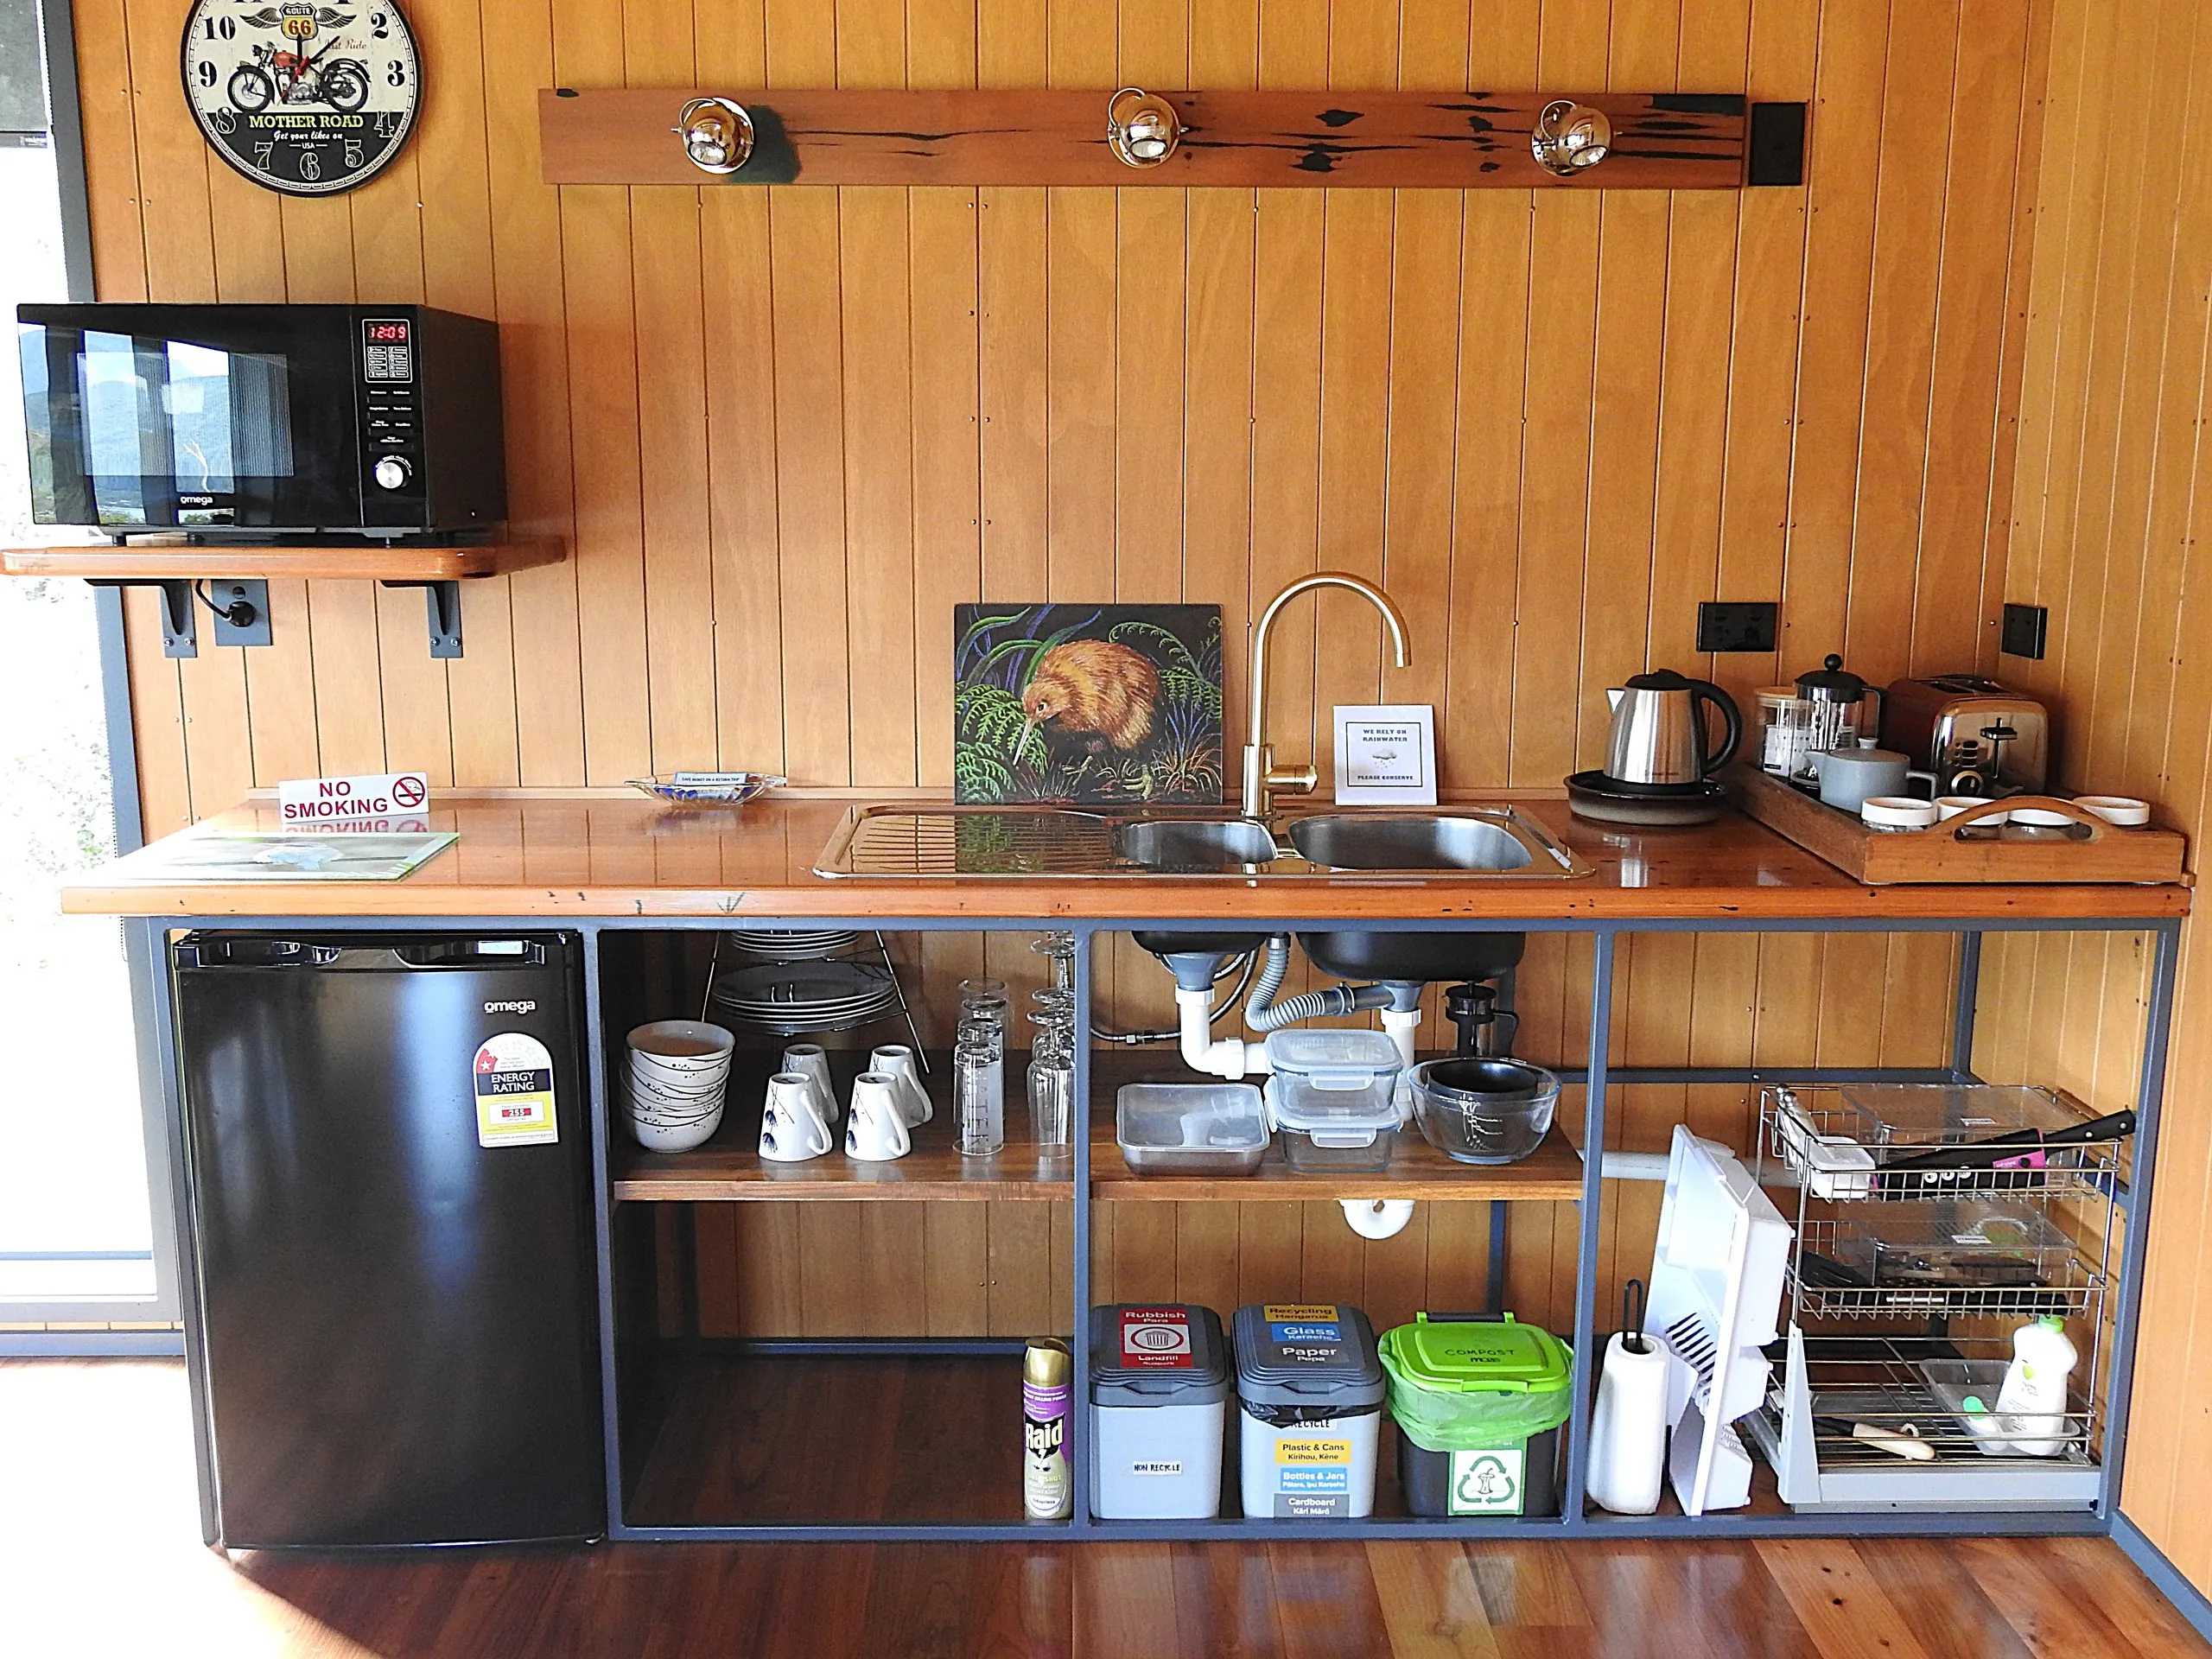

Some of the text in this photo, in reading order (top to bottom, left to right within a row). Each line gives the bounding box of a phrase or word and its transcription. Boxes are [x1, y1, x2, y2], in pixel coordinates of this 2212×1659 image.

[202, 16, 236, 40] 10
[288, 19, 312, 35] 66
[371, 13, 389, 39] 2
[199, 61, 217, 87] 9
[387, 60, 405, 86] 3
[216, 106, 236, 134] 8
[249, 115, 364, 128] MOTHER ROAD
[373, 111, 394, 138] 4
[273, 130, 289, 141] Get
[254, 142, 273, 169] 7
[345, 139, 364, 168] 5
[300, 152, 321, 181] 6
[368, 326, 406, 339] 12:09
[180, 496, 213, 505] omega
[320, 781, 351, 797] NO
[284, 798, 388, 819] SMOKING
[484, 1001, 536, 1014] omega
[491, 1071, 535, 1084] ENERGY
[493, 1081, 535, 1093] RATING
[1282, 1347, 1337, 1357] Paper
[1026, 1418, 1063, 1450] Raid
[1288, 1497, 1336, 1506] Cardboard
